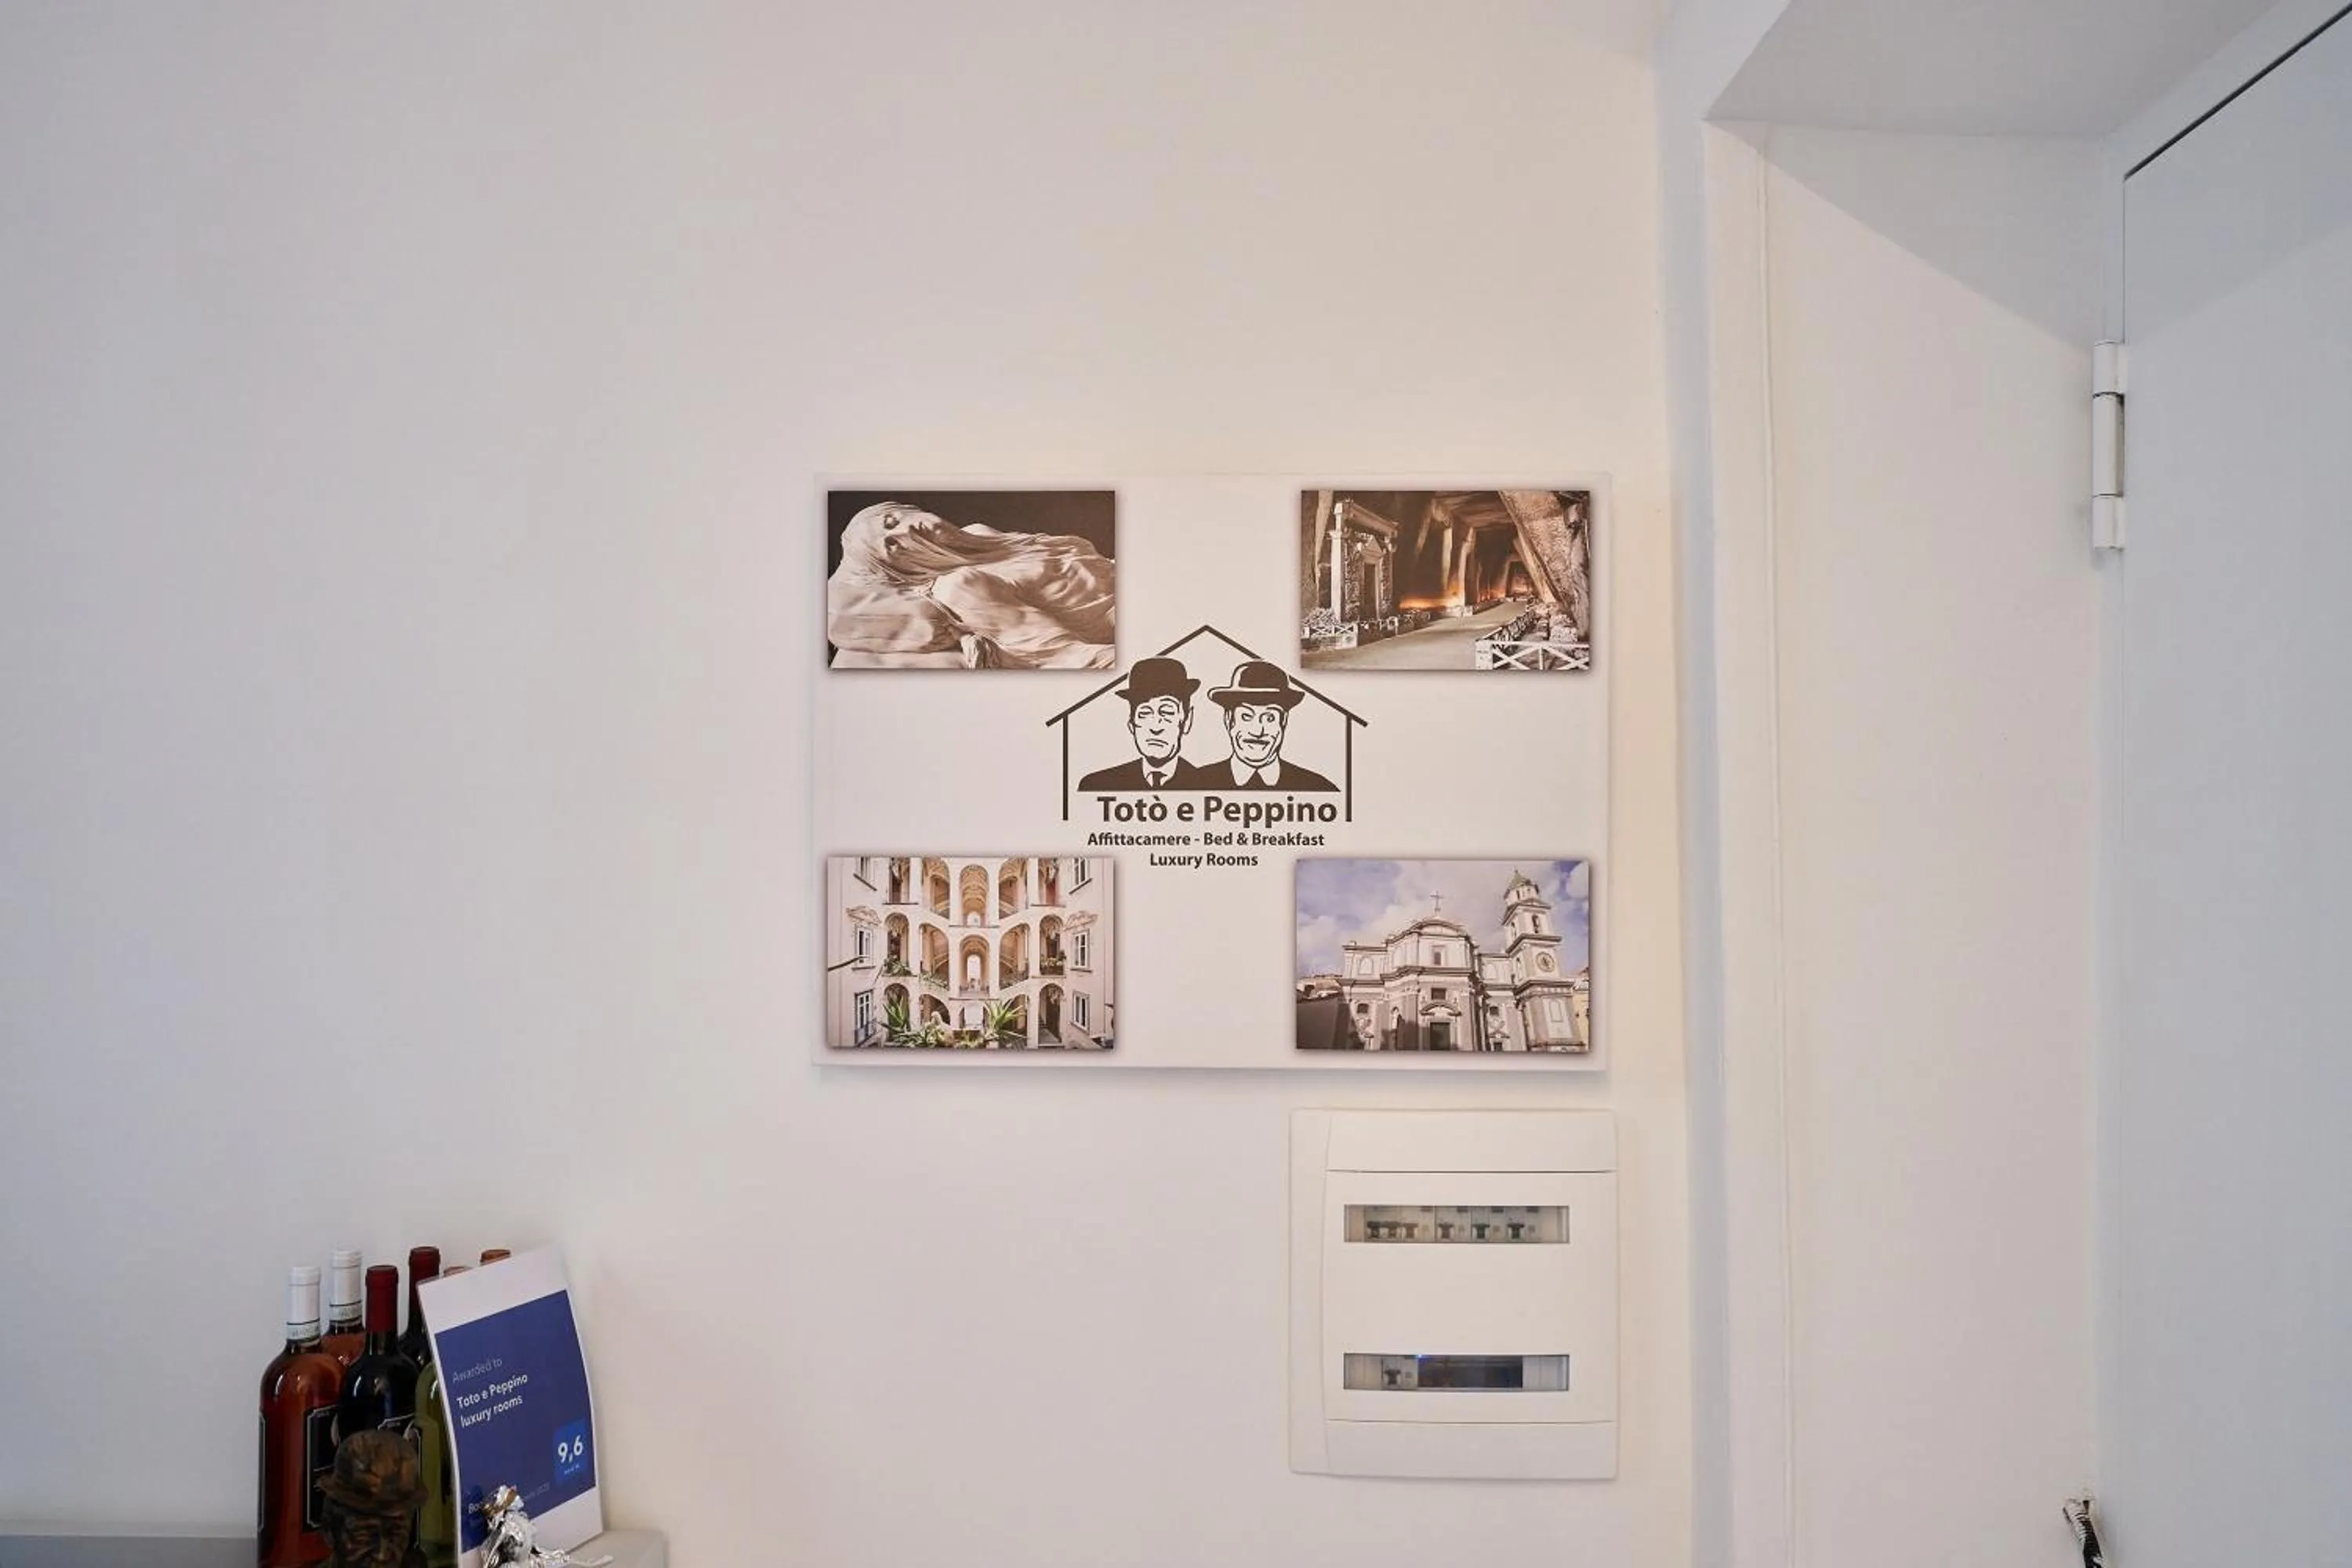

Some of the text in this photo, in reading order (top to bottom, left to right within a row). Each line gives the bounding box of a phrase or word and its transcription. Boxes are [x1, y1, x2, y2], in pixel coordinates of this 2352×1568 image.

[1097, 795, 1338, 829] Totò e Peppino
[1087, 832, 1191, 846] Affittacamere
[1203, 832, 1233, 846] Bed
[1236, 832, 1249, 846] &
[1252, 832, 1325, 846] Breakfast
[1150, 852, 1259, 869] Luxury Rooms
[493, 1357, 503, 1368] to
[481, 1390, 488, 1399] e
[488, 1374, 528, 1396] Peppino
[460, 1396, 523, 1428] luxury rooms
[557, 1435, 583, 1463] 9,6
